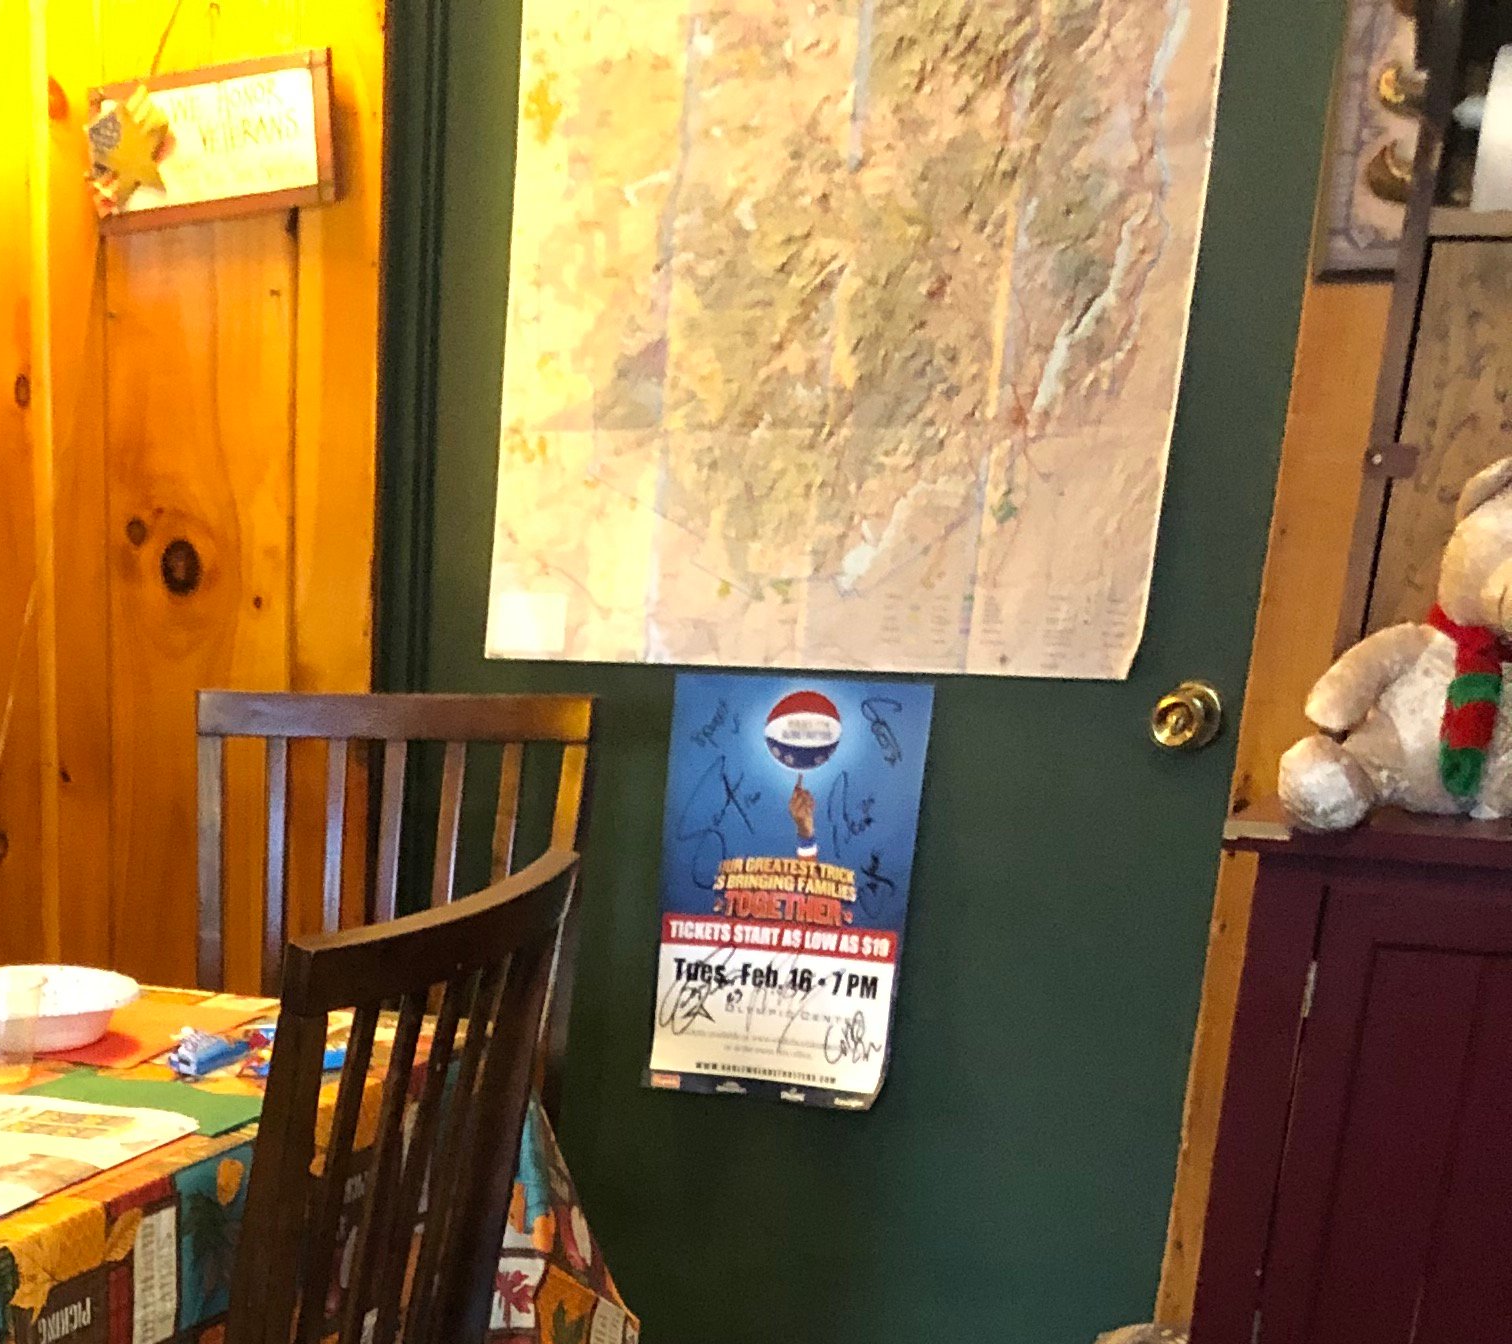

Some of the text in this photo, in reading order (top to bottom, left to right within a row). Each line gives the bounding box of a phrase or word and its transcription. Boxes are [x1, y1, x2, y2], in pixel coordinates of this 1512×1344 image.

[745, 856, 816, 878] GREATEST
[819, 862, 855, 885] TRICK
[712, 873, 857, 903] S BRINGING FAMILIES
[724, 889, 842, 927] TOGETHER
[669, 919, 731, 943] TICKETS
[733, 926, 781, 946] START
[782, 928, 803, 949] AS
[804, 931, 839, 951] LOW
[839, 934, 859, 954] AS
[832, 971, 845, 996] 7
[846, 973, 879, 1000] PM
